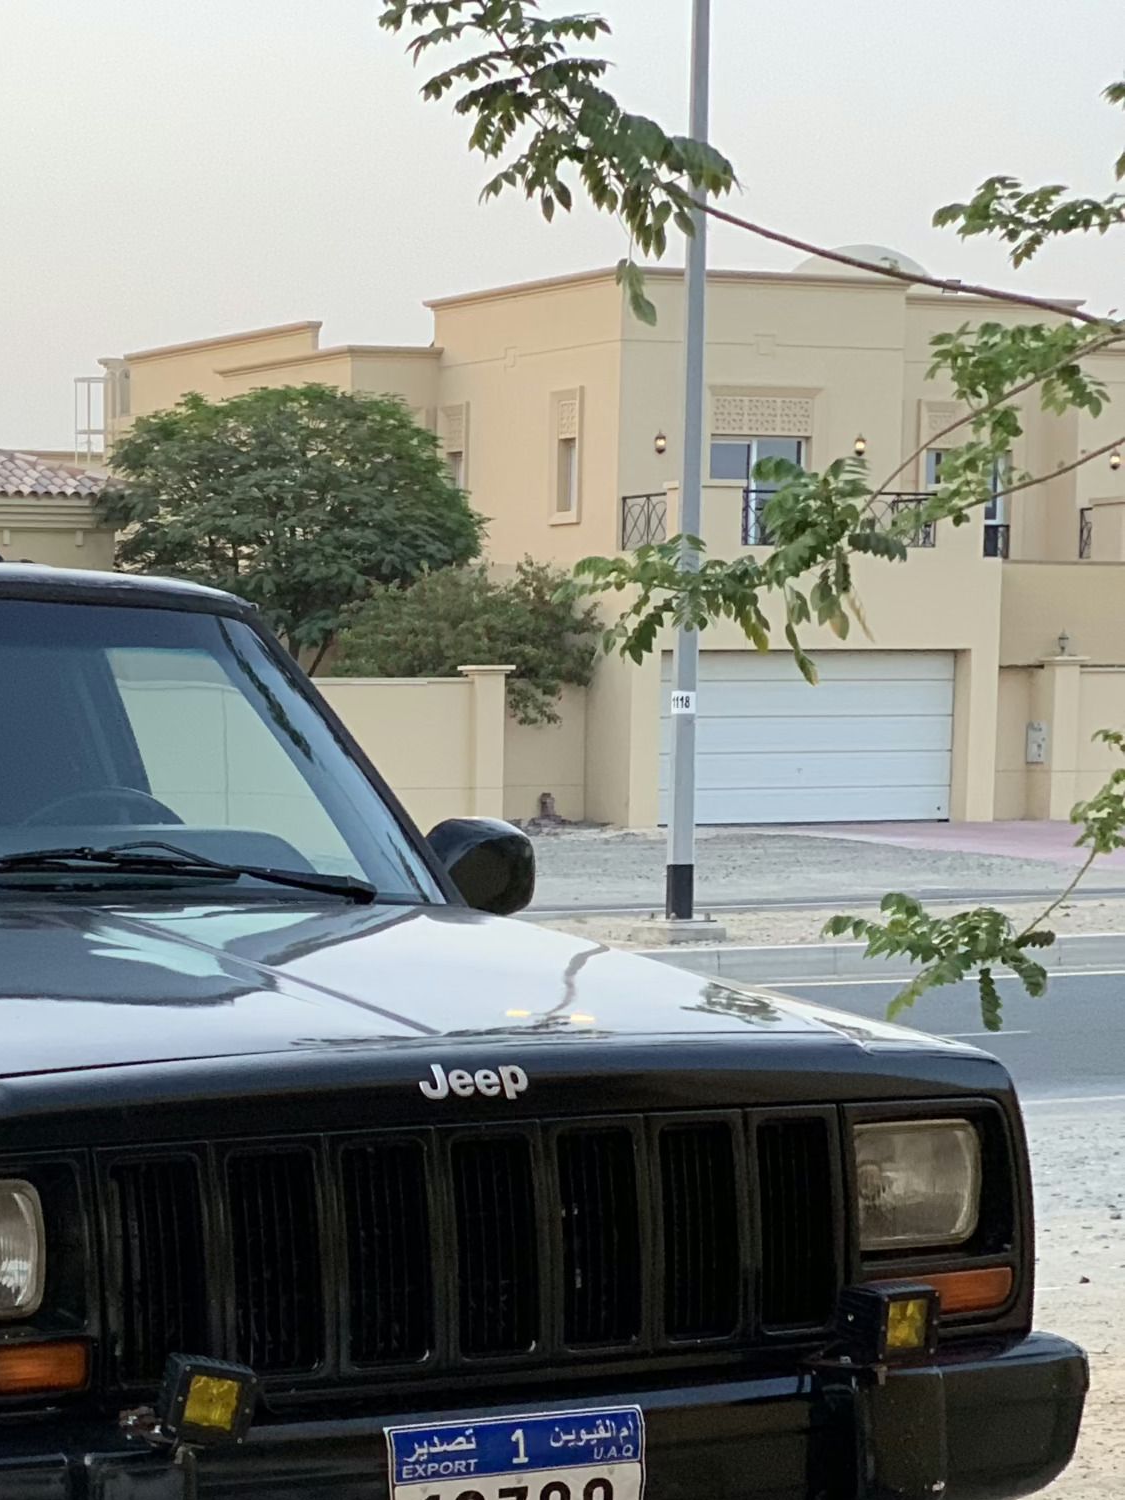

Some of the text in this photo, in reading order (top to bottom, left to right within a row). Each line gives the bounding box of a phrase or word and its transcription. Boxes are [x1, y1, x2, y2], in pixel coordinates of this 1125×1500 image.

[419, 1064, 528, 1100] Jeep
[403, 1428, 476, 1462] تصدير
[511, 1428, 529, 1464] 1
[550, 1419, 615, 1447] القيوين
[402, 1459, 478, 1478] EXPORT
